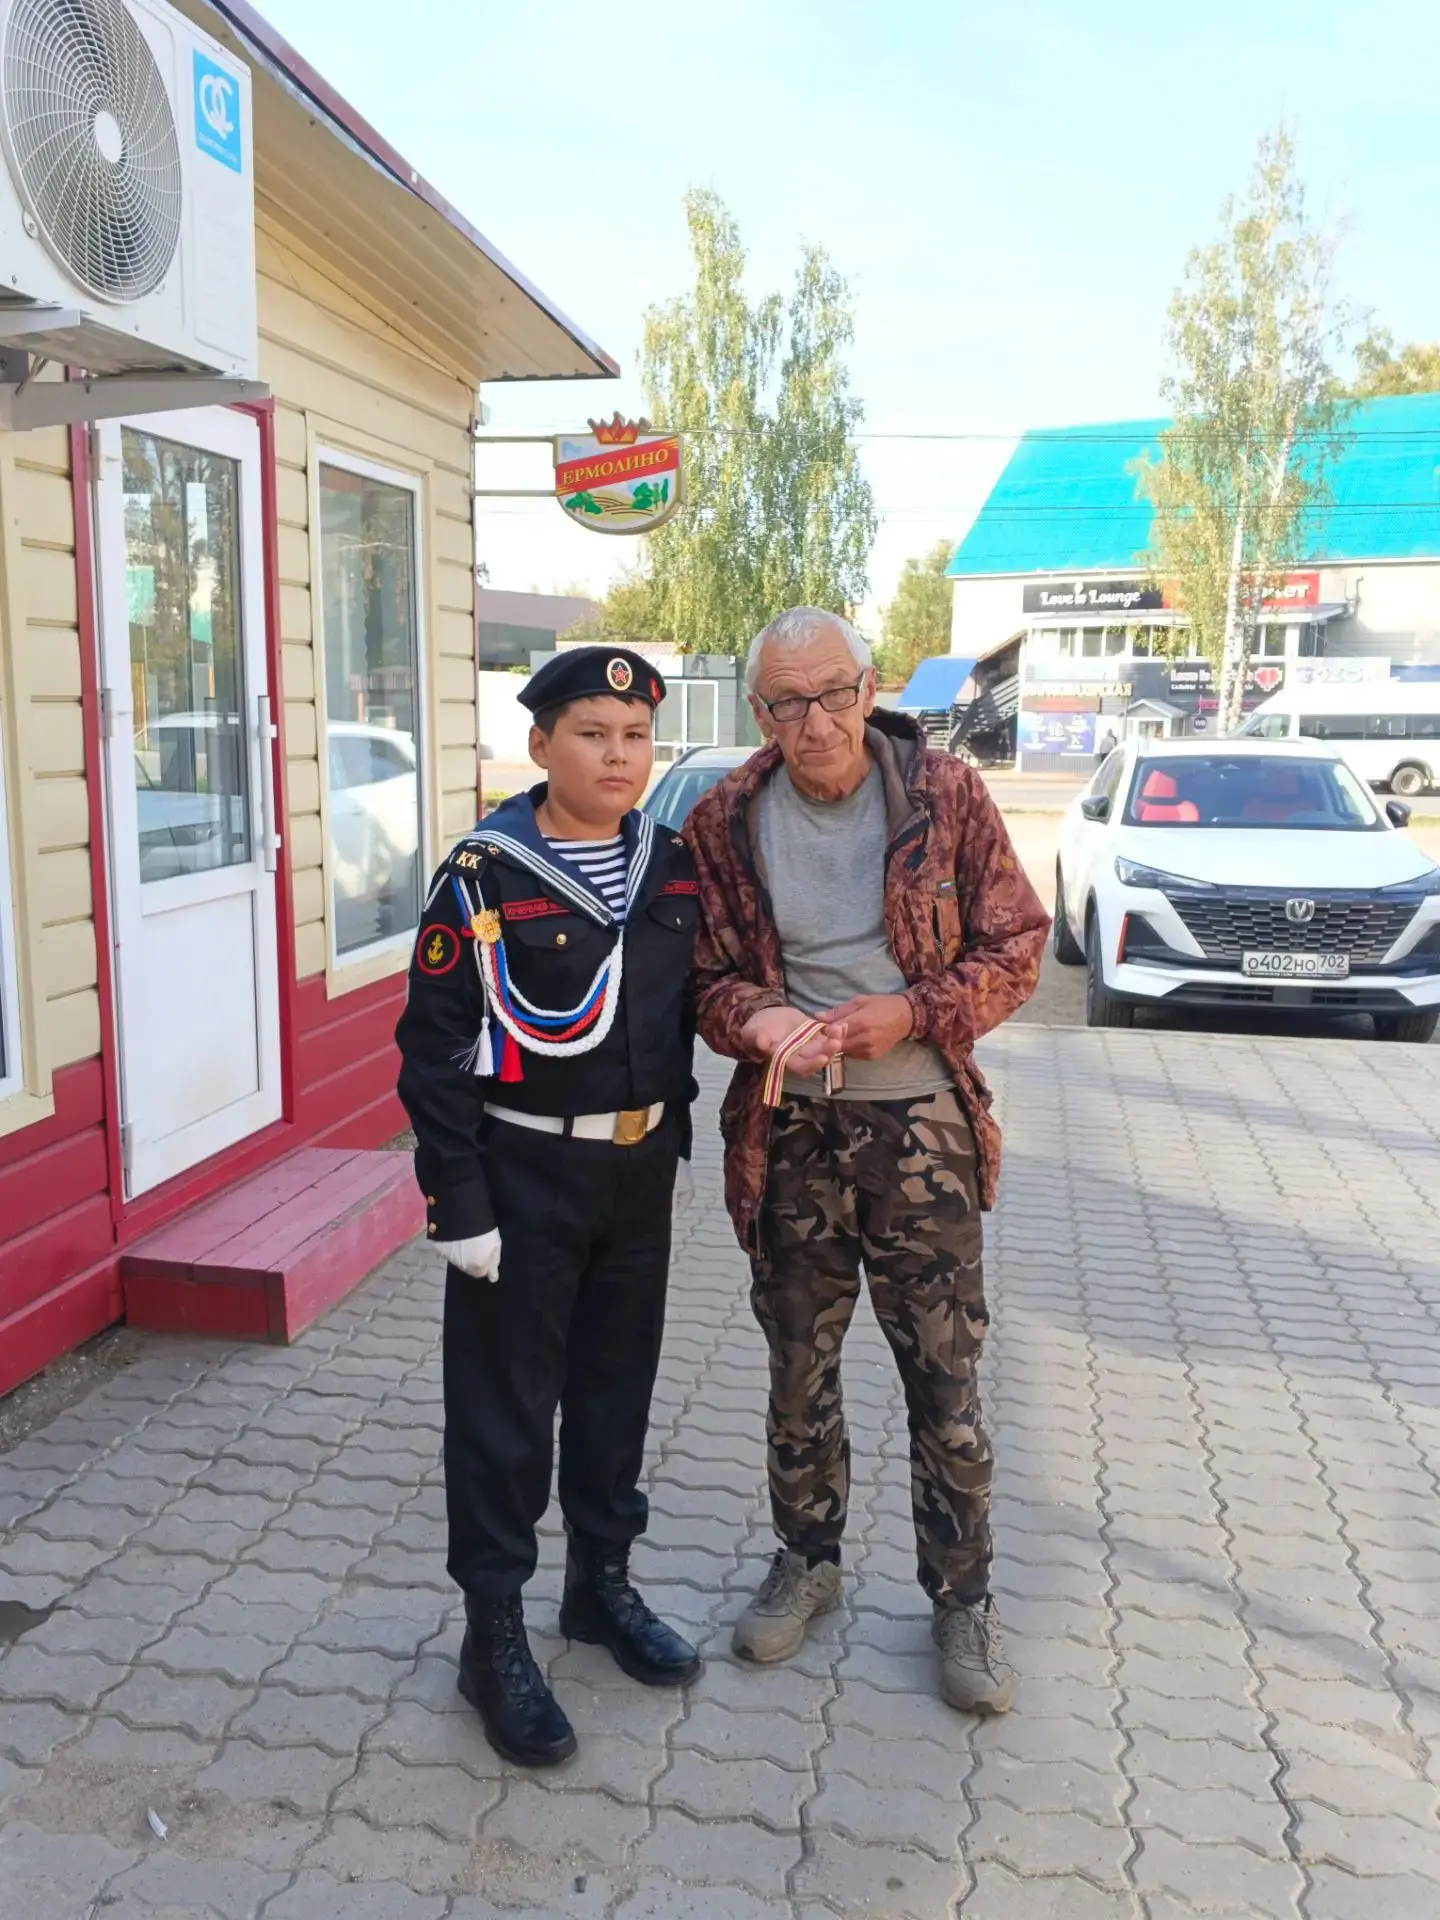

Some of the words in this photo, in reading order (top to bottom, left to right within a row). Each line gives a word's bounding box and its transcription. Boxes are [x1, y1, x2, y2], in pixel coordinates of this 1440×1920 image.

[563, 449, 668, 485] ЕРМОЛИНО
[1040, 591, 1074, 605] Love
[1088, 589, 1142, 607] Lounge
[1248, 955, 1315, 971] О402НО
[1319, 955, 1345, 968] 702
